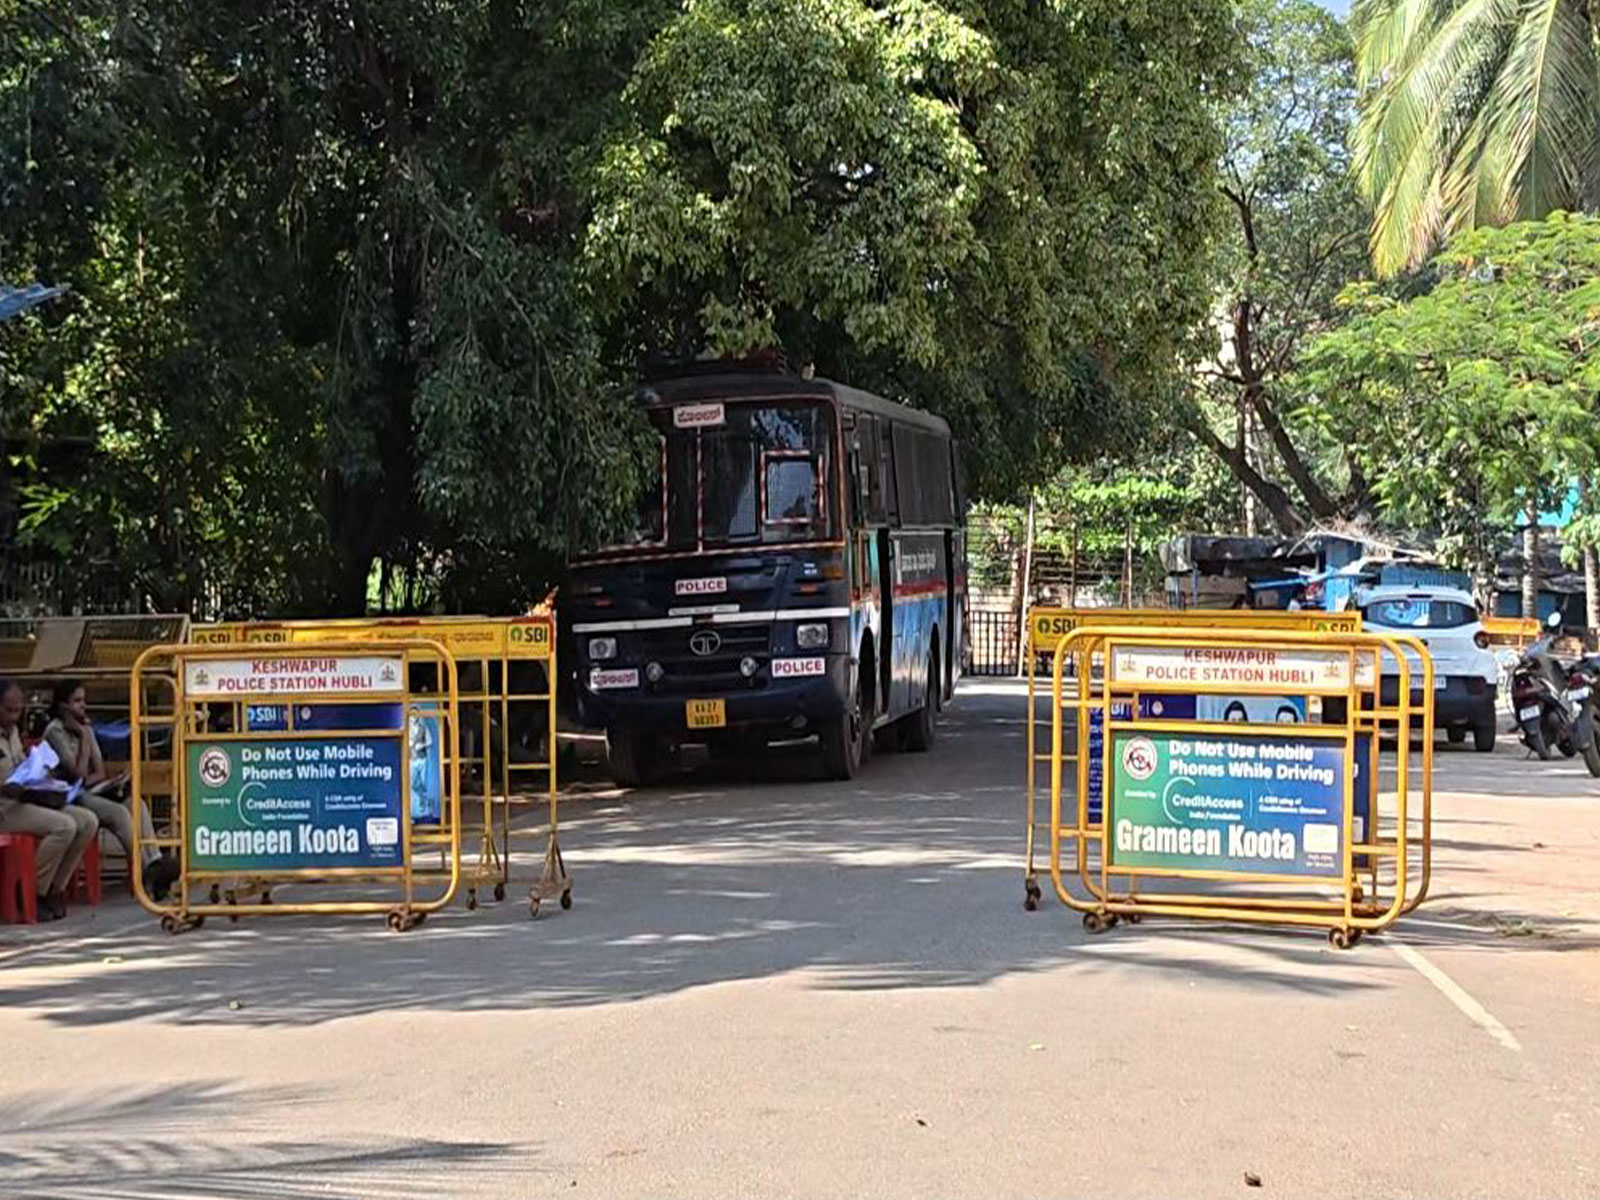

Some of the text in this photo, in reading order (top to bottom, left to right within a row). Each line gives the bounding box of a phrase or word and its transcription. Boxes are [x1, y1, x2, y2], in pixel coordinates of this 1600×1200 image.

[677, 580, 724, 592] POLICE
[1053, 618, 1077, 634] SBI
[525, 627, 548, 643] SBI
[1184, 649, 1276, 665] KESHWAPUR
[252, 659, 337, 673] KESHWAPUR
[774, 660, 822, 674] POLICE
[1146, 666, 1314, 683] POLICE STATION HUBLI
[218, 675, 372, 691] POLICE STATION HUBLI
[256, 706, 276, 722] SBI
[241, 745, 373, 762] Do Not Use Mobile
[1169, 740, 1314, 761] Do Not Use Mobile
[242, 762, 392, 780] Phones While Driving
[1169, 760, 1225, 778] Phones
[1228, 762, 1272, 779] While
[1276, 764, 1334, 785] Driving
[246, 798, 311, 810] CreditAccess
[1172, 794, 1244, 809] CreditAccess
[195, 825, 292, 855] Grameen
[299, 824, 359, 854] Koota
[1117, 819, 1294, 859] Grameen Koota
